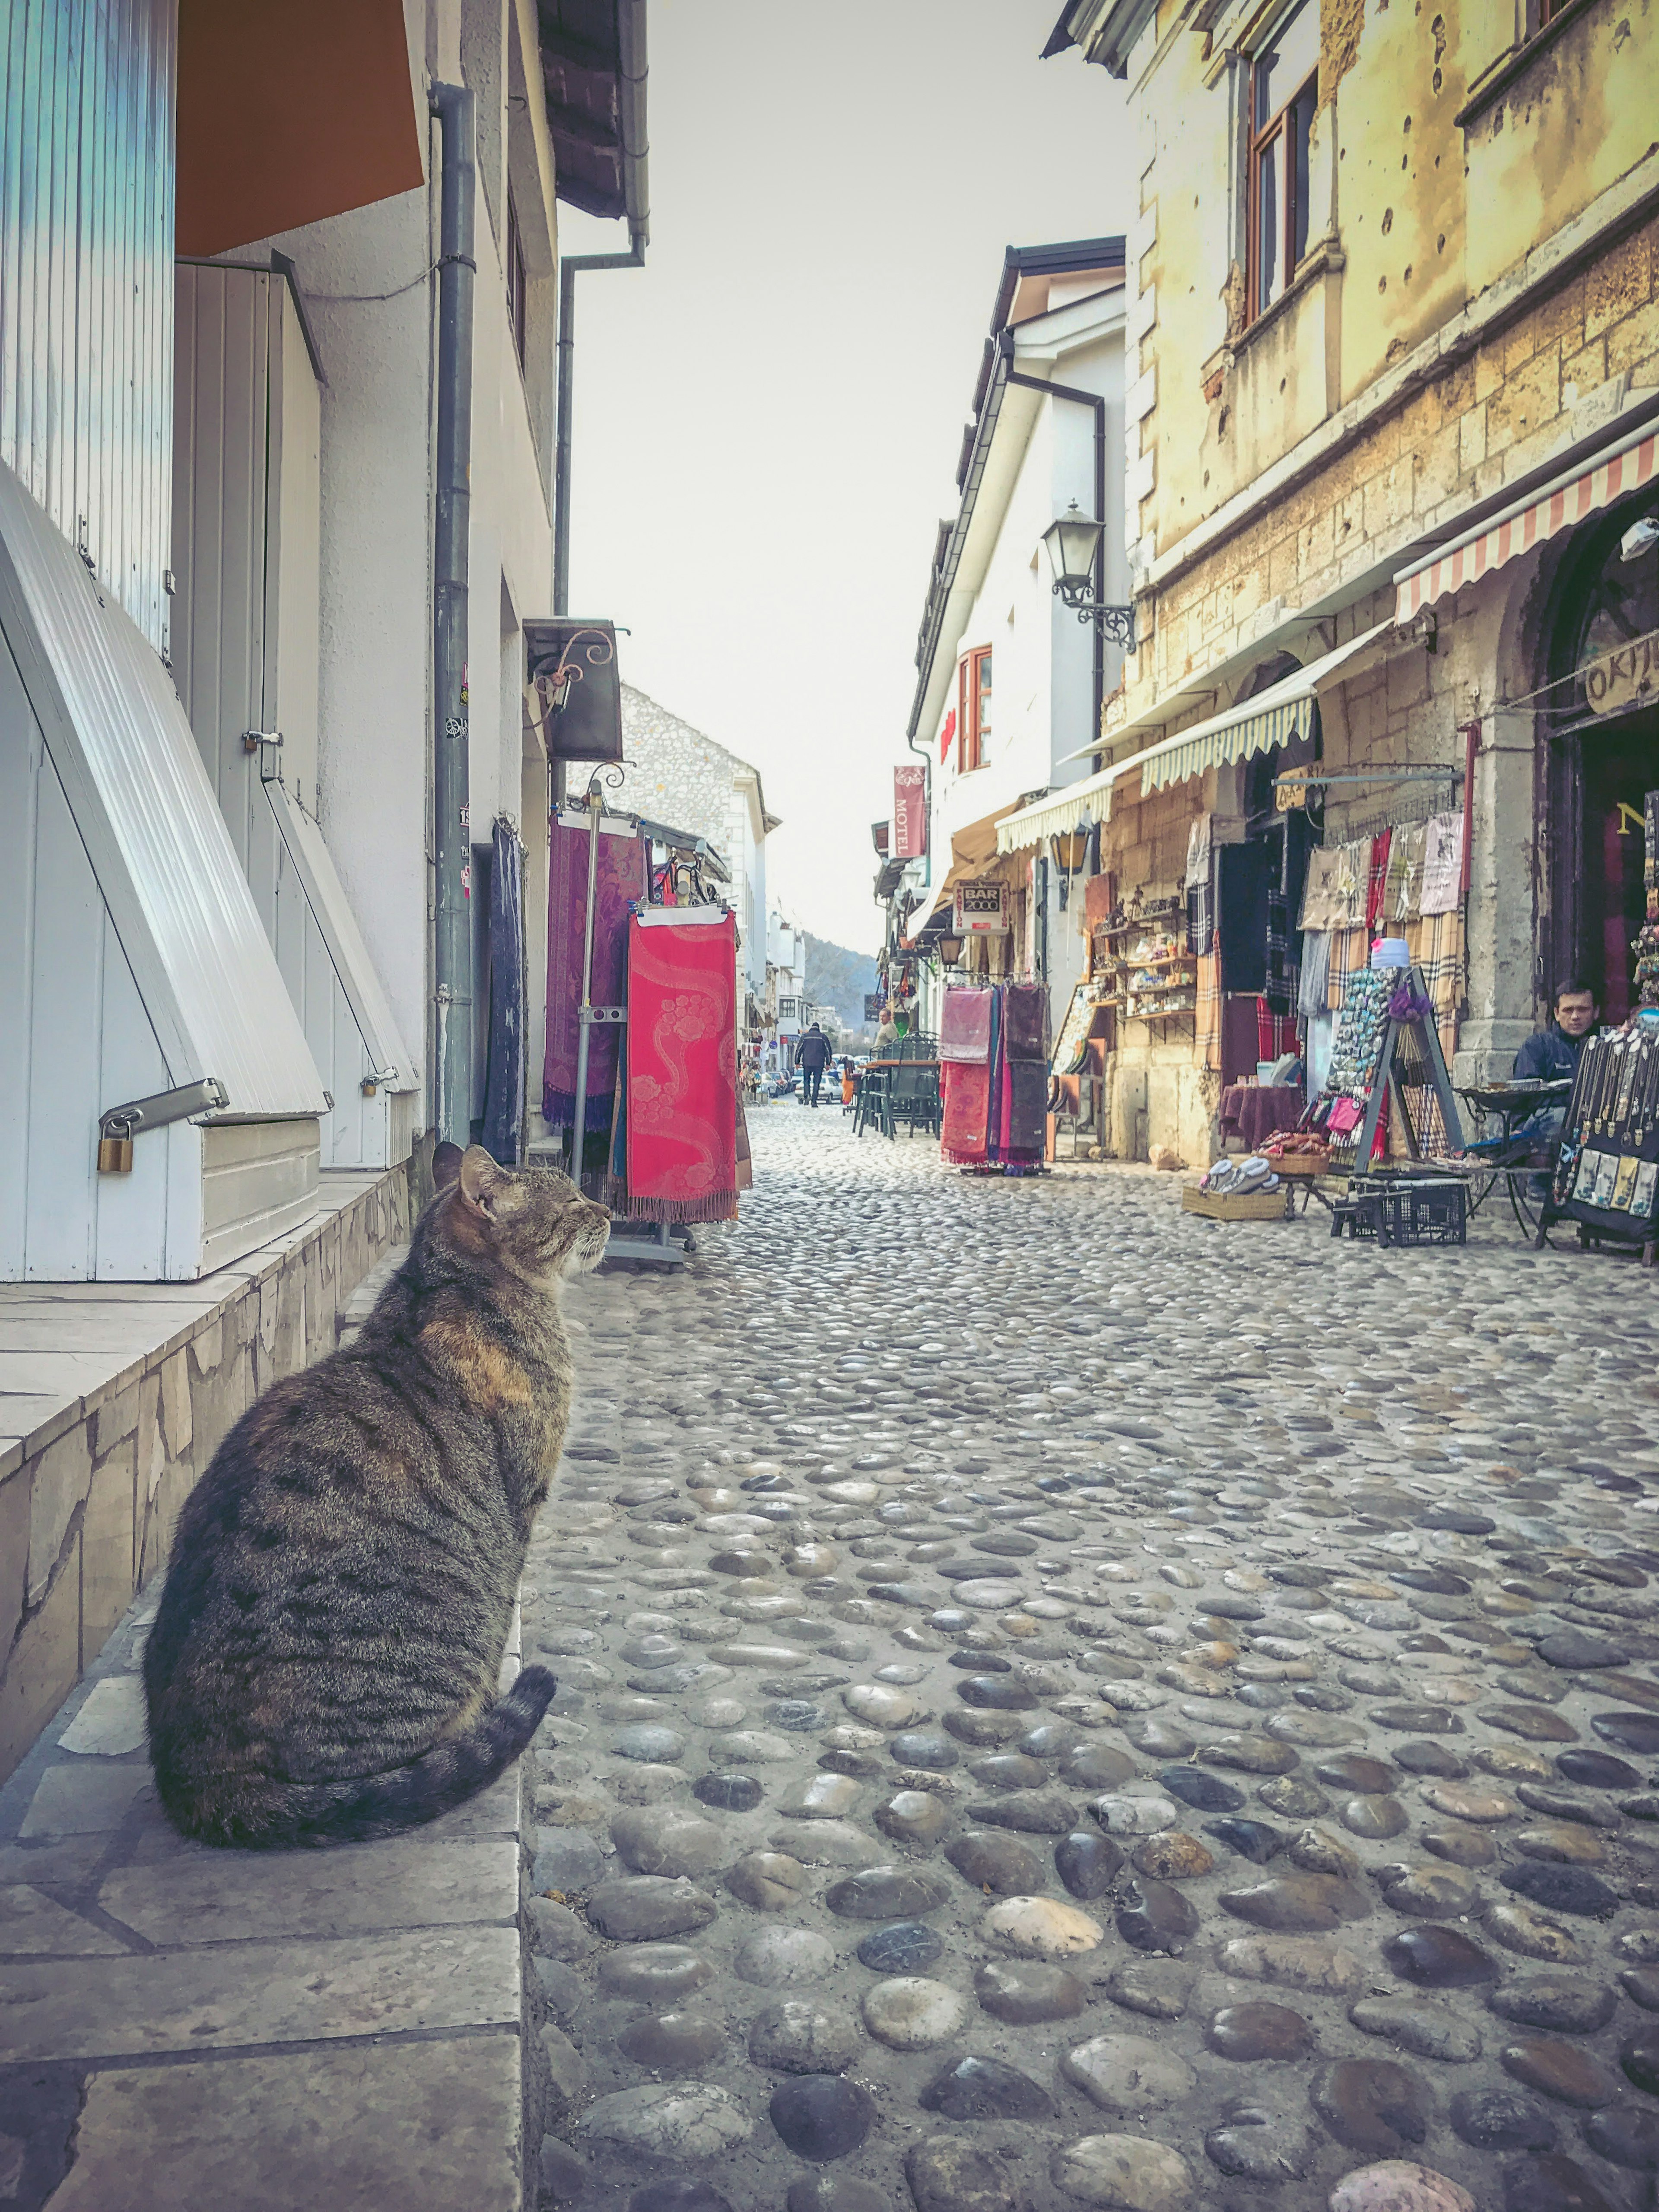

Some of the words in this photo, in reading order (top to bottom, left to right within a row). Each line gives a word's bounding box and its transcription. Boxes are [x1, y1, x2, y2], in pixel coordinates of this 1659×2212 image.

[896, 799, 909, 854] MOTEL
[965, 890, 998, 899] BAR
[965, 900, 998, 911] 2000
